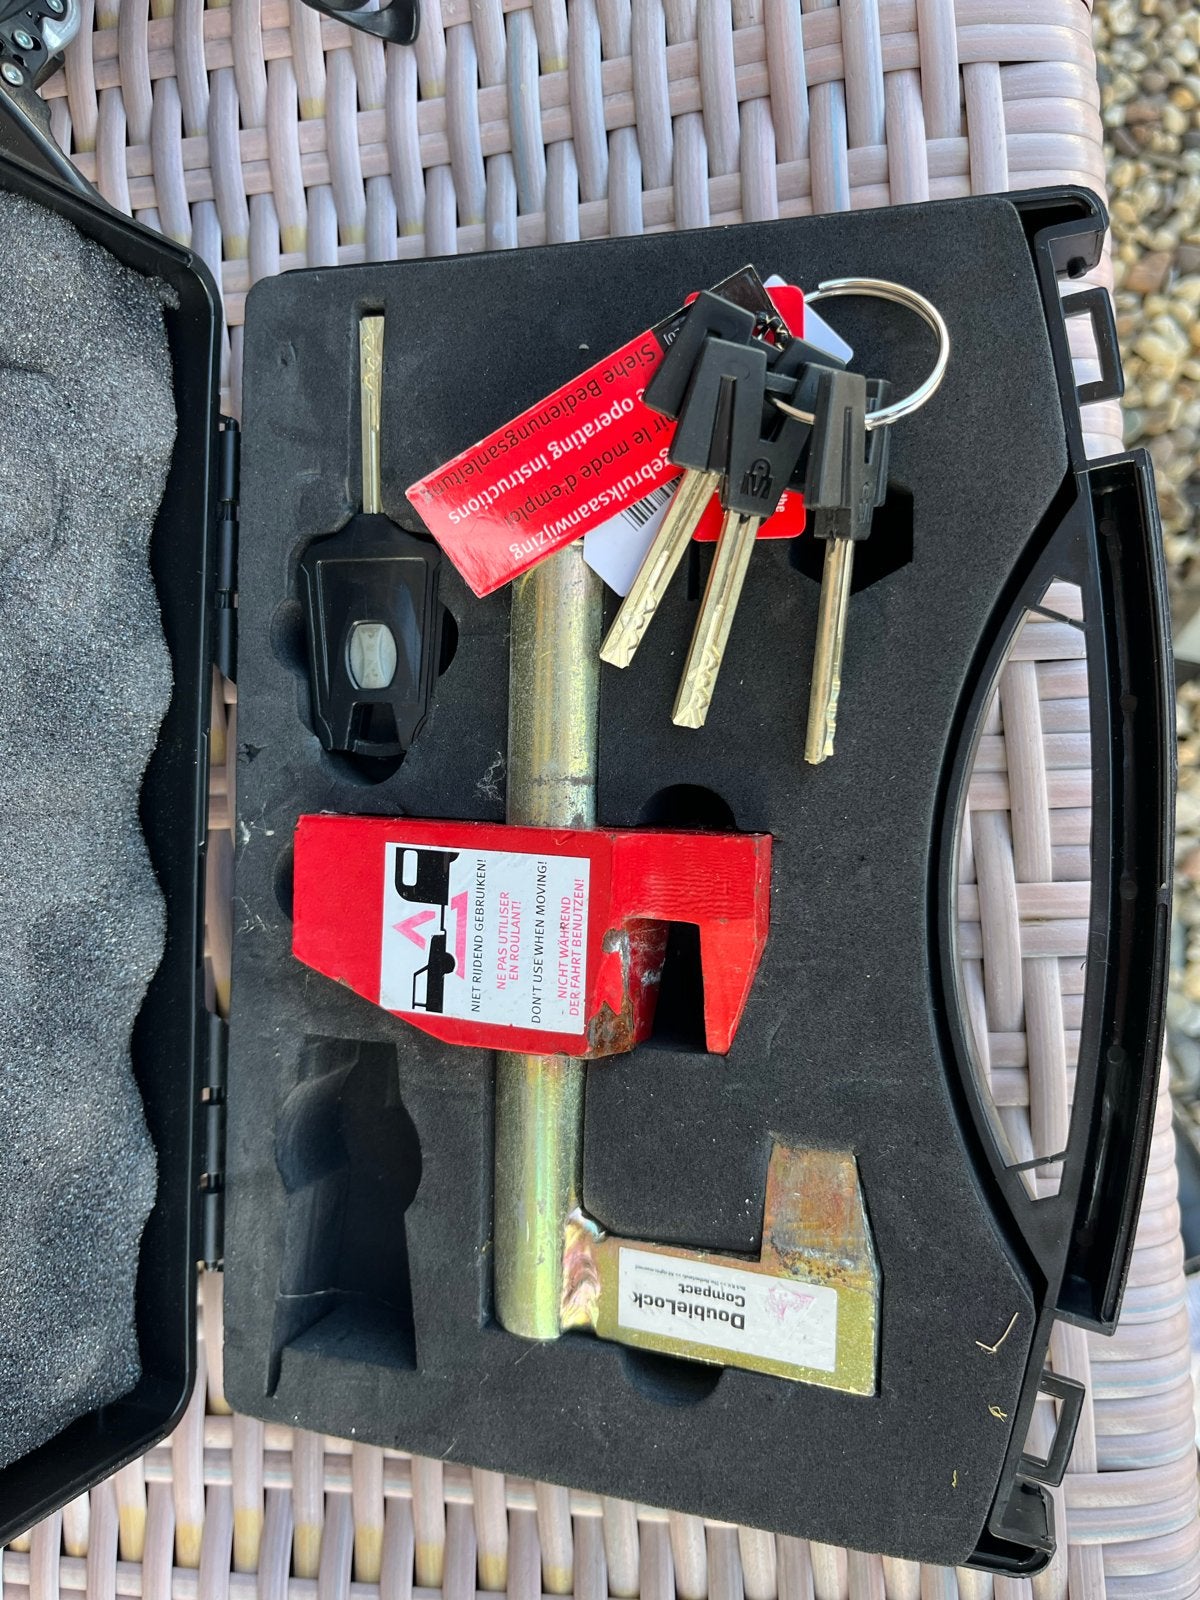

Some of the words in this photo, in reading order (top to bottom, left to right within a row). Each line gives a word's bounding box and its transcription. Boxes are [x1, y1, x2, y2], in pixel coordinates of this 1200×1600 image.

[602, 343, 656, 384] Siehe
[547, 398, 634, 461] operating
[632, 428, 652, 445] le
[580, 440, 629, 478] mode
[448, 454, 551, 525] instructions
[504, 474, 577, 527] d'emploi
[509, 448, 671, 560] gebruiksaanwijzing
[474, 859, 486, 932] GEBRUIKEN!
[535, 861, 547, 916] MOVING!
[498, 892, 509, 943] UTILISER
[510, 901, 521, 962] ROULANT!
[558, 896, 571, 960] WÄHREND
[572, 879, 584, 947] BENUTZEN!
[533, 919, 544, 957] WHEN
[473, 943, 483, 983] RIJDEND
[498, 945, 508, 970] PAS
[509, 965, 518, 981] EN
[533, 959, 543, 985] USE
[570, 951, 582, 988] FAHRT
[471, 986, 480, 1012] NIET
[497, 973, 505, 990] NE
[558, 962, 568, 998] NICHT
[532, 988, 542, 1023] DON'T
[569, 990, 579, 1016] DER
[678, 1283, 746, 1308] Compact
